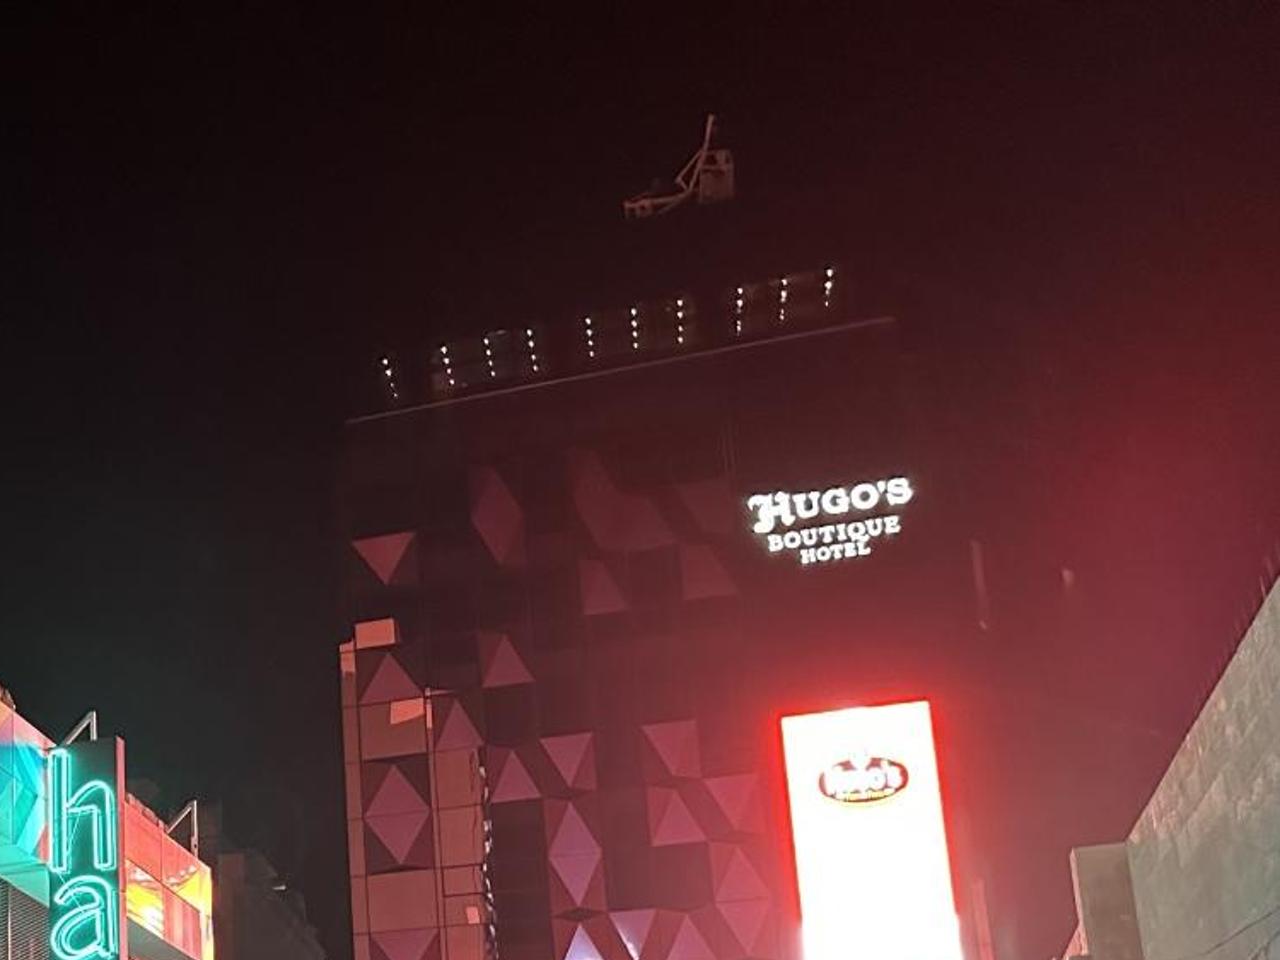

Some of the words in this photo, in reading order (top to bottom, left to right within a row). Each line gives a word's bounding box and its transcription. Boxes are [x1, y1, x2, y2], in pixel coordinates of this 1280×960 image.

[747, 477, 913, 533] HUGO'S
[767, 515, 901, 552] BOUTIQUE
[800, 541, 871, 564] HOTEL
